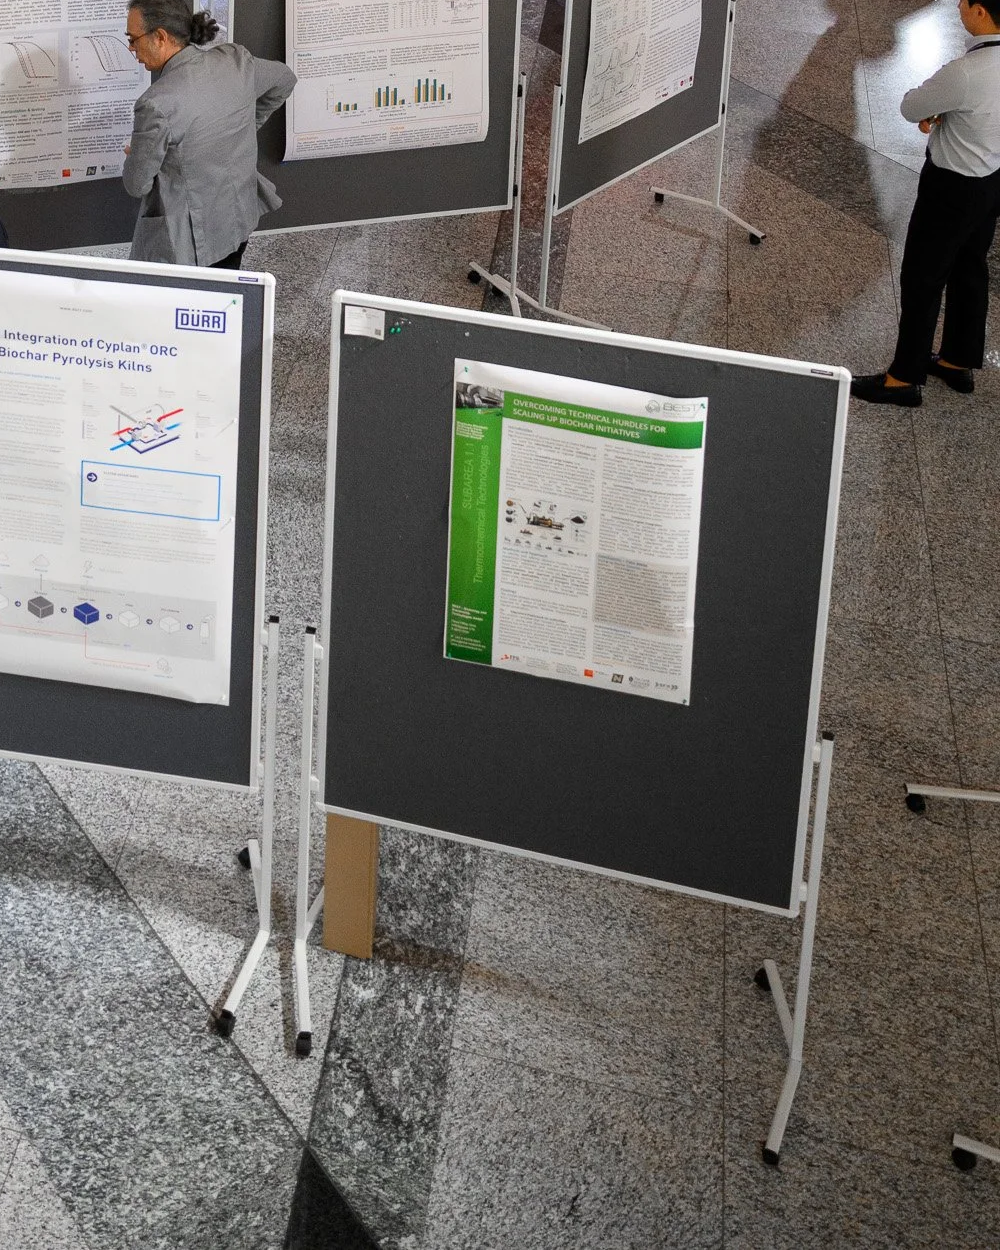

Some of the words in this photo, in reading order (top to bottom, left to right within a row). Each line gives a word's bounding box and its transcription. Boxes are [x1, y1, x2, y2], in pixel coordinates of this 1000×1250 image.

[180, 309, 221, 329] DÜRR
[4, 330, 76, 346] Integration
[81, 339, 93, 348] of
[150, 345, 178, 357] ORC
[53, 353, 114, 369] Pyrolysis
[118, 360, 152, 373] Kilns
[513, 399, 566, 415] OVERCOMING
[568, 408, 610, 424] TECHNICAL
[612, 417, 648, 431] HURDLES
[650, 424, 666, 433] FOR
[663, 402, 697, 412] BEST
[513, 408, 545, 420] SCALING
[547, 414, 558, 423] UP
[559, 417, 594, 430] BIOCHAR
[596, 424, 640, 439] INITIATIVES
[464, 443, 474, 455] 1.1
[462, 459, 473, 508] SUBAREA
[476, 445, 490, 506] Technologies
[473, 508, 486, 583] Thermochemical
